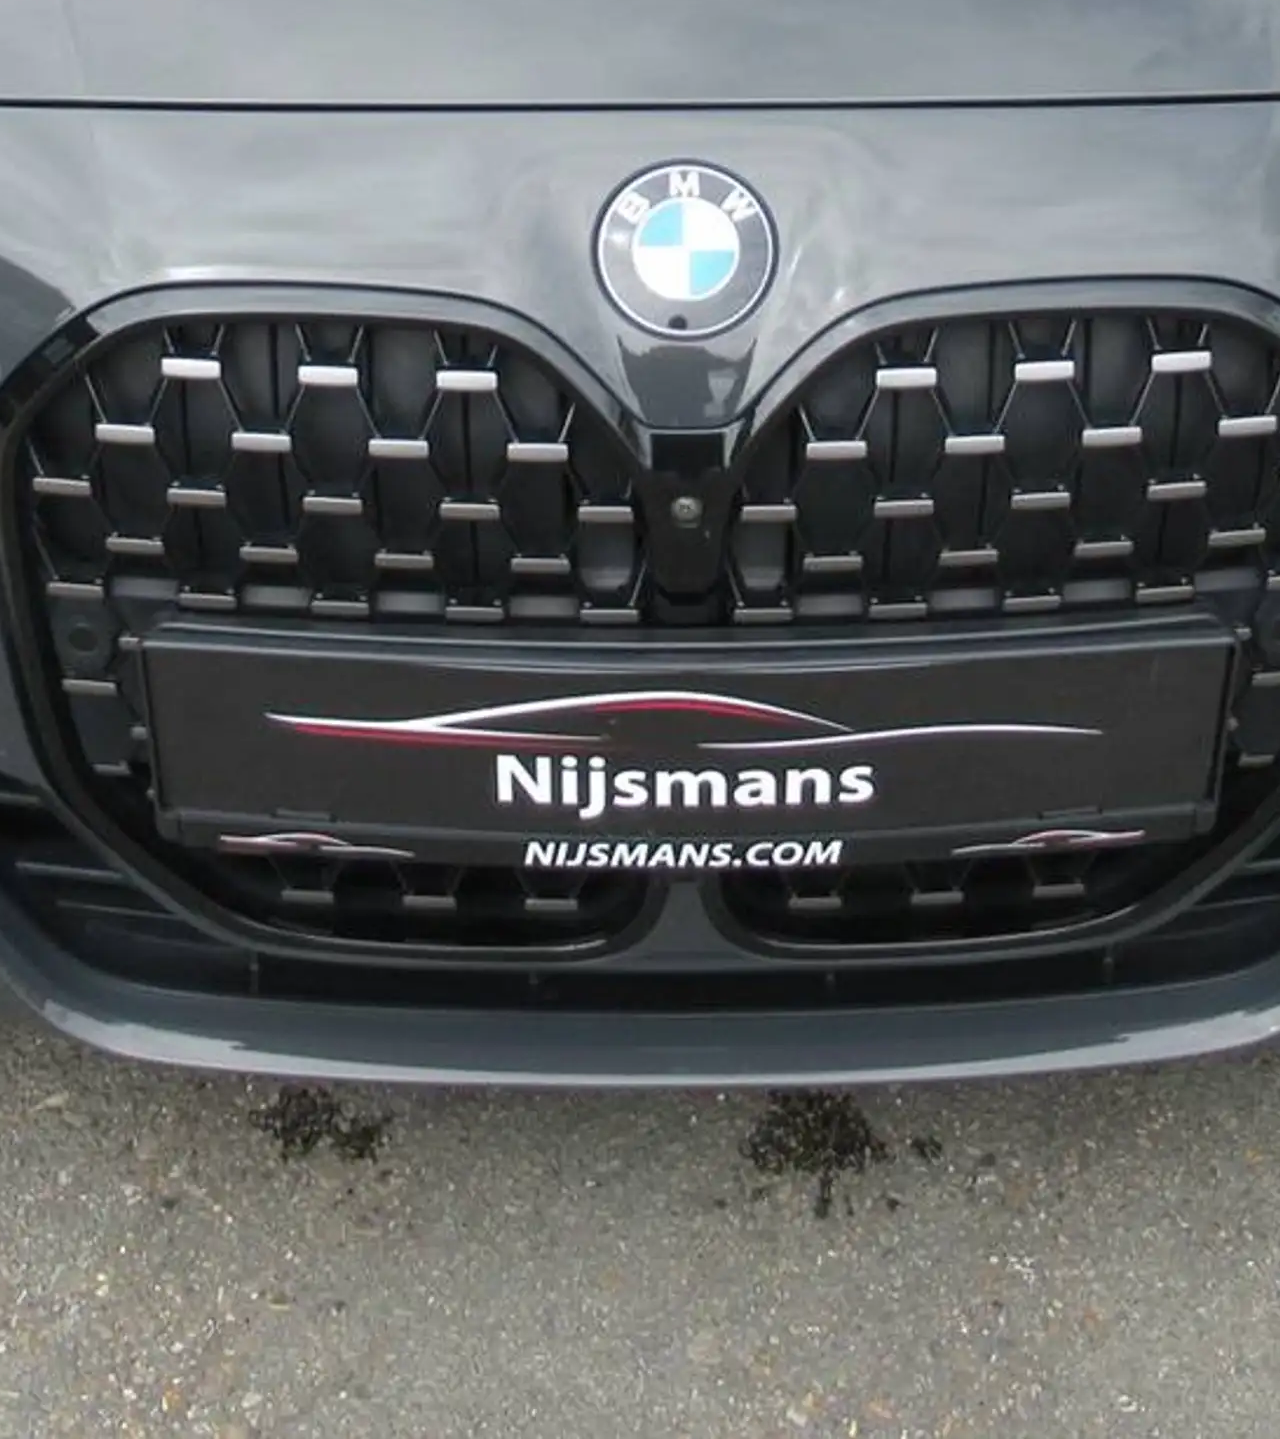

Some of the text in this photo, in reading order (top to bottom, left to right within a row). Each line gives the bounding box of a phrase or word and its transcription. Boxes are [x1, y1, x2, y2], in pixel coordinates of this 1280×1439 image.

[616, 170, 757, 225] BMW
[496, 754, 875, 820] Nijsmans
[524, 840, 843, 868] NIJSMANS.COM
